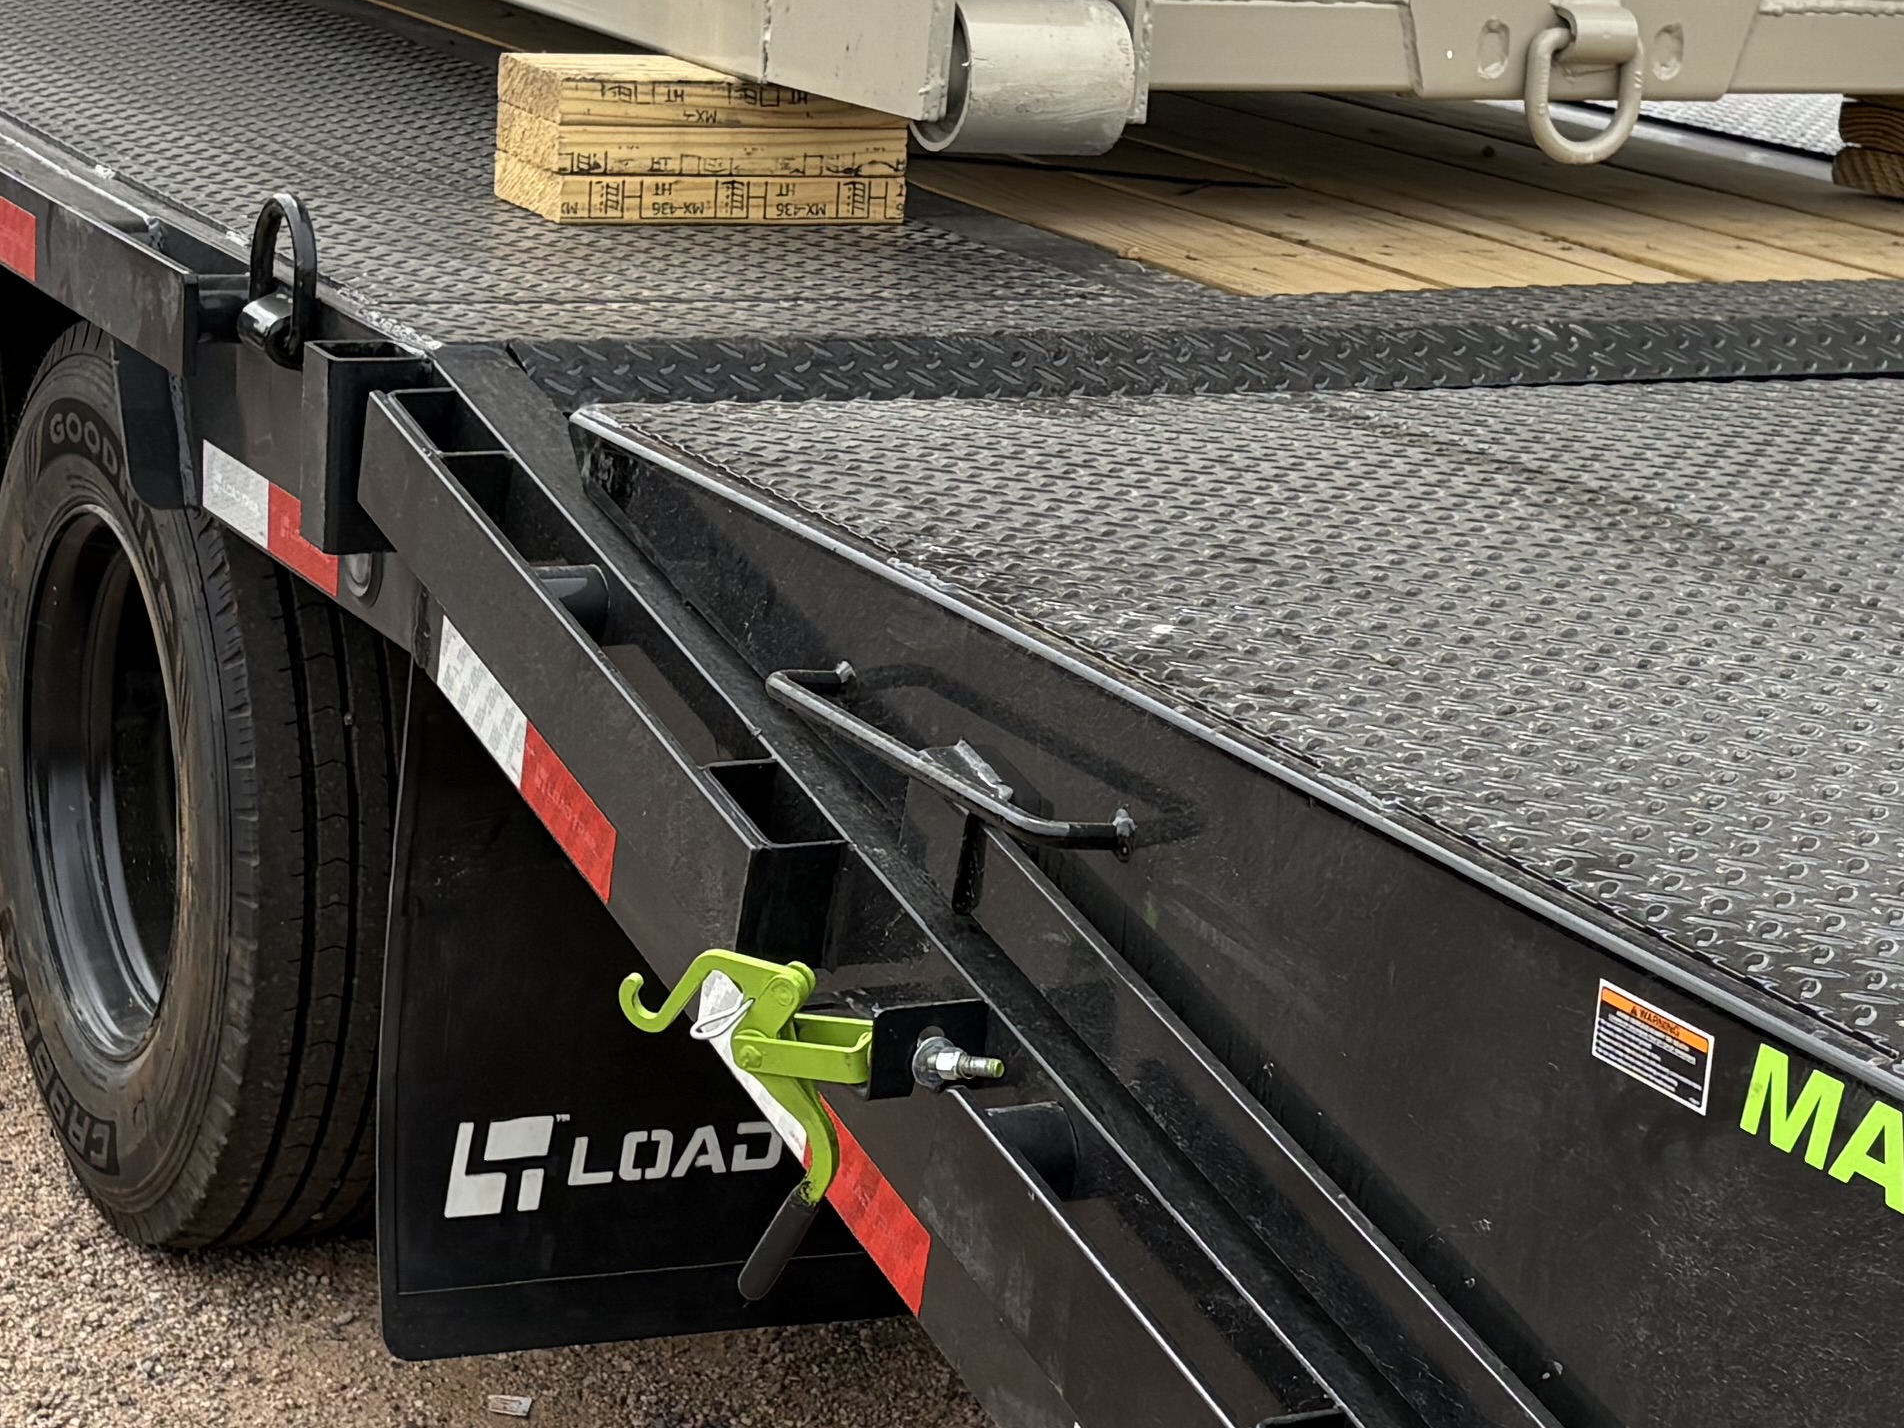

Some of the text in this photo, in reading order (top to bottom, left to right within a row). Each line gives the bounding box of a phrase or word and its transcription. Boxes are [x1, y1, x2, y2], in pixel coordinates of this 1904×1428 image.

[654, 183, 673, 196] HT
[776, 183, 796, 197] HT
[652, 201, 705, 215] MX-436
[776, 203, 827, 216] MX-436
[1639, 1009, 1681, 1038] WARNING
[568, 1121, 783, 1186] LOAD
